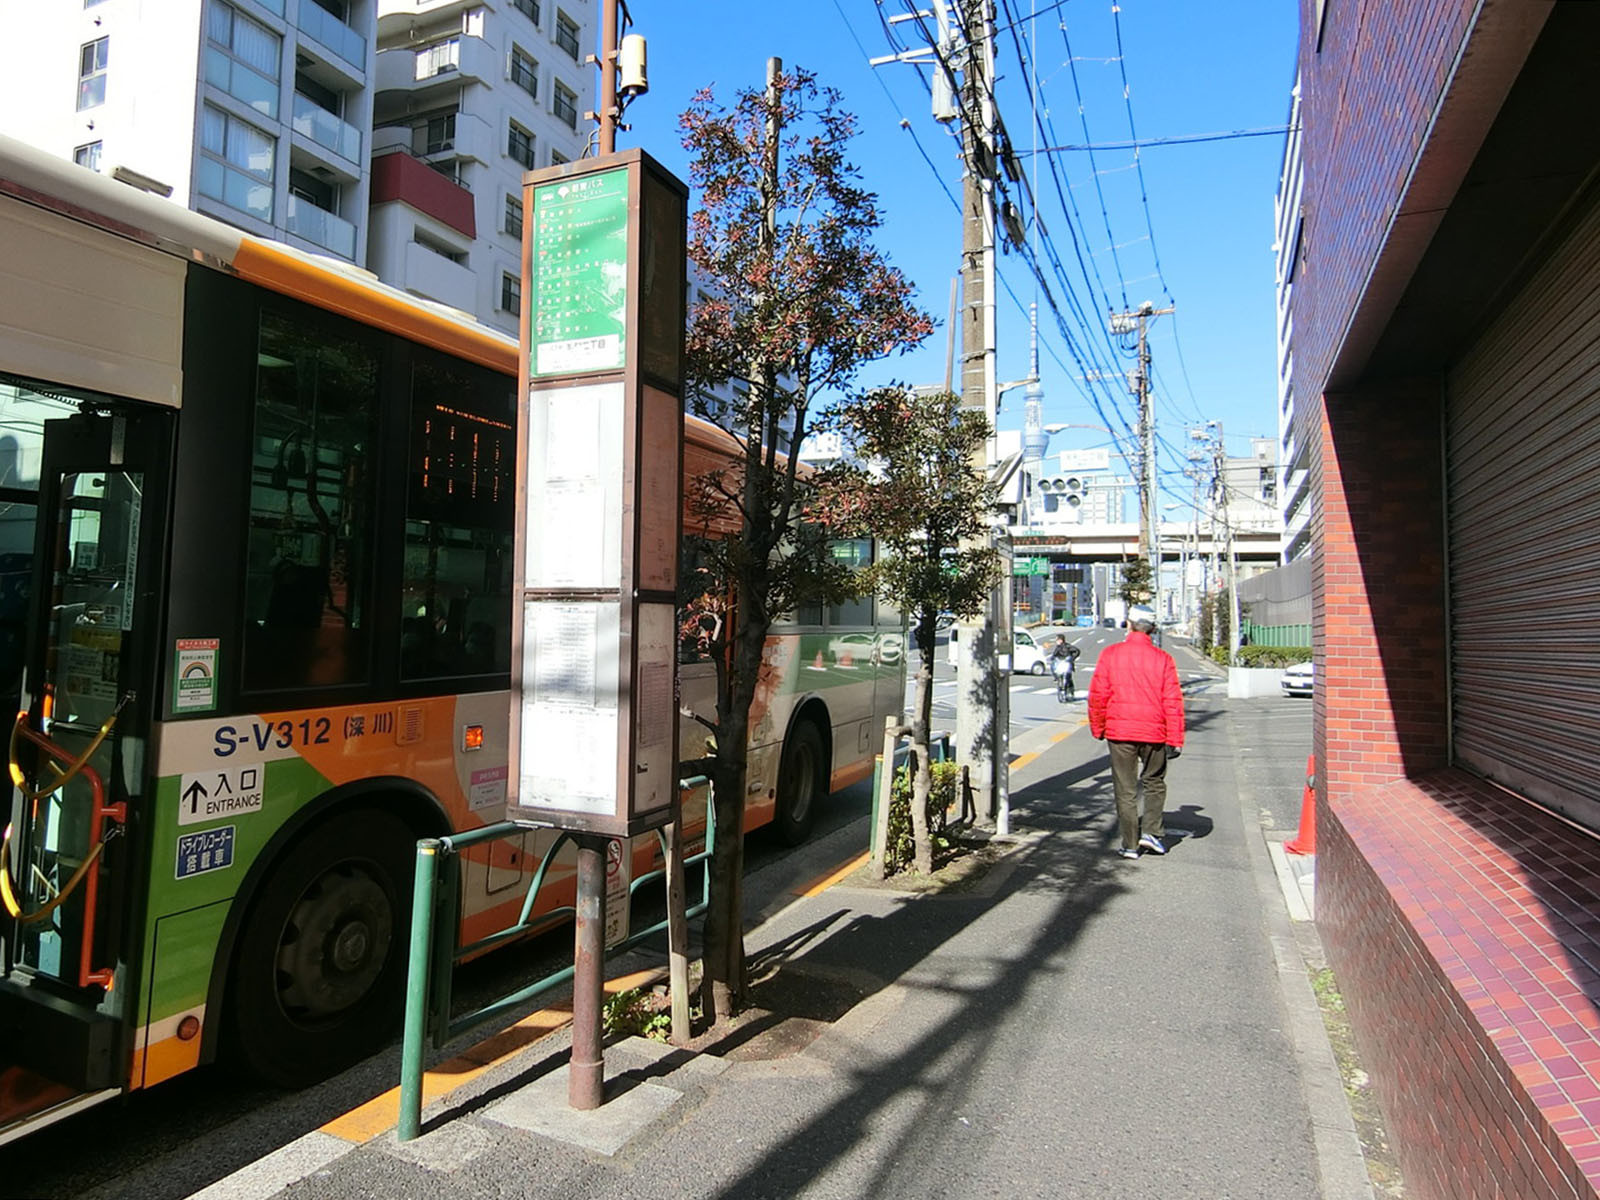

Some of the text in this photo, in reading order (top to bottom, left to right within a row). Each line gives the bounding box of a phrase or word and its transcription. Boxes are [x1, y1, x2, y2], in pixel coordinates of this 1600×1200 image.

[213, 717, 330, 757] S-V312
[214, 769, 256, 797] 入口
[206, 794, 261, 815] ENTRANCE
[186, 848, 225, 874] 搭載車
